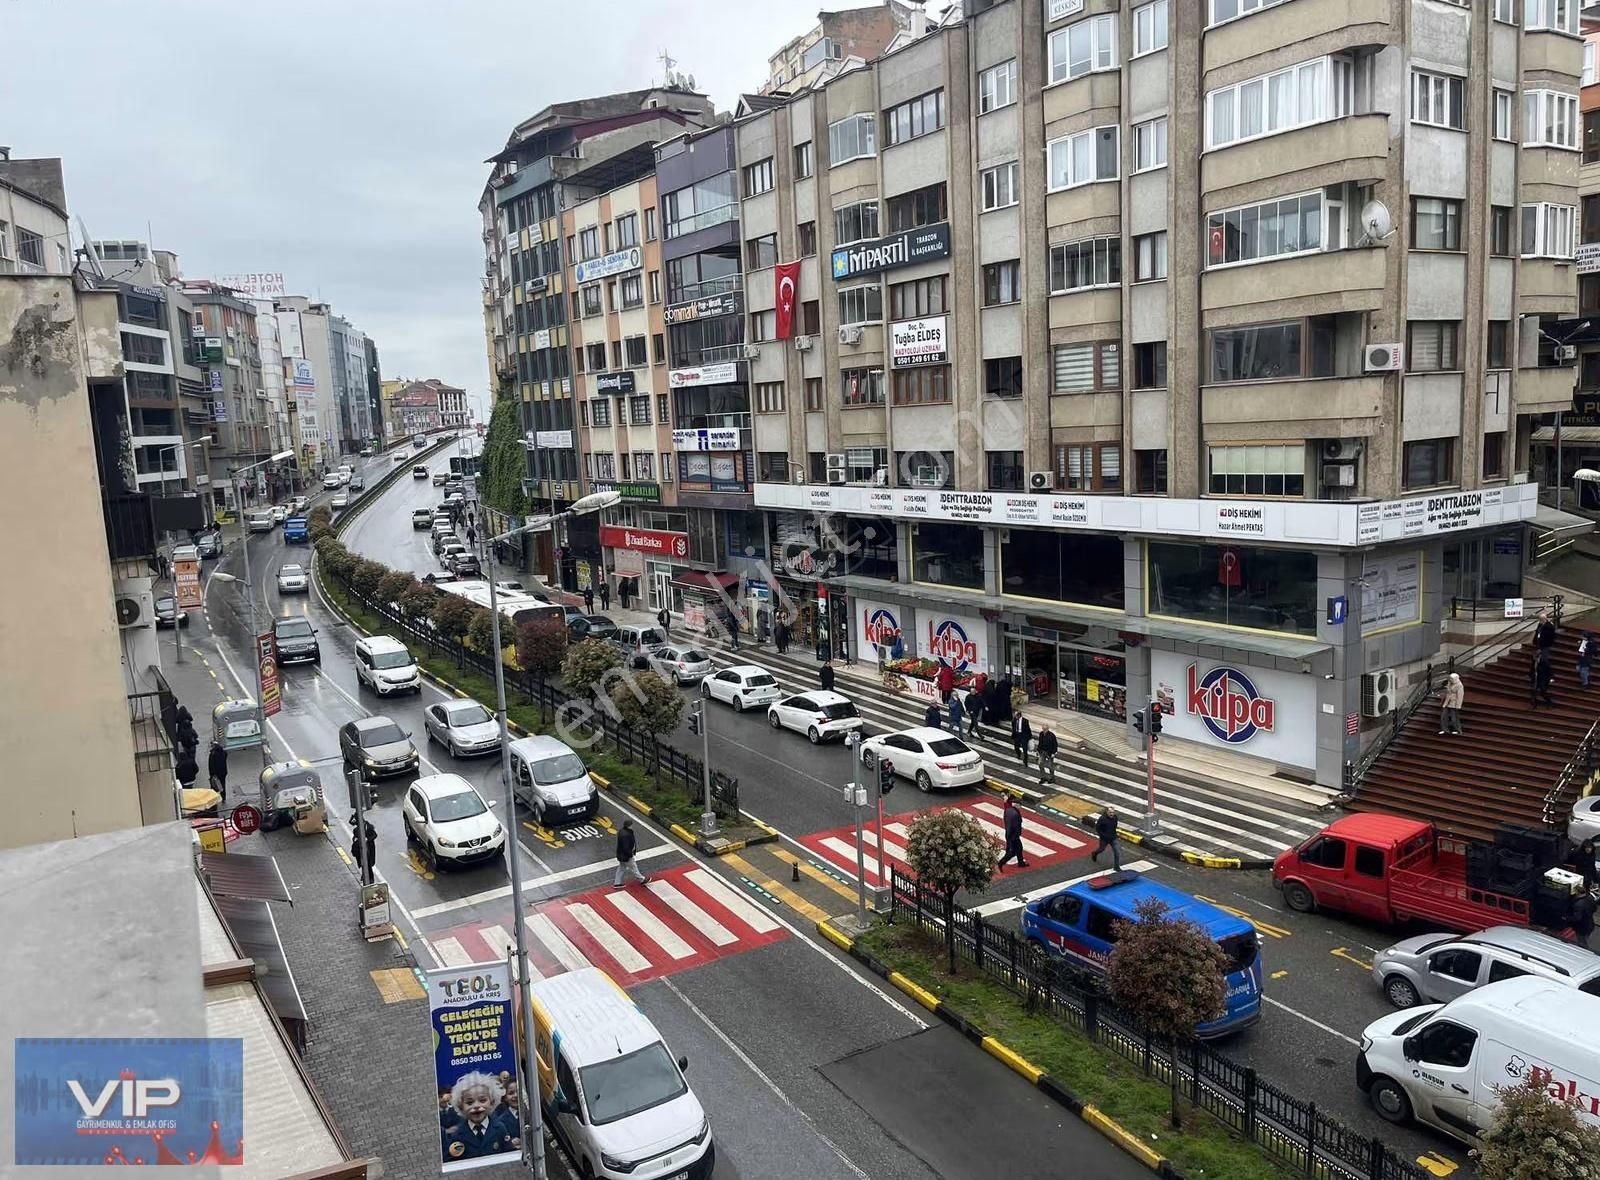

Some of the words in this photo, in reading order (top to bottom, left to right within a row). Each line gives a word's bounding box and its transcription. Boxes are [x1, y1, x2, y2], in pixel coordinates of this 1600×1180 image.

[916, 233, 937, 244] TRABZON
[894, 333, 916, 347] Tuğba
[917, 328, 941, 342] ELDEŞ
[1228, 507, 1238, 519] DİŞ
[1239, 508, 1262, 519] HEKİMİ
[929, 620, 977, 669] kilpa
[916, 680, 935, 697] TAZE
[1186, 661, 1274, 742] kilpa
[438, 974, 500, 998] TEOL
[443, 994, 478, 1004] ANAOKULU
[439, 1005, 504, 1023] GELECEĞİN
[444, 1015, 501, 1034] DAHİLERİ
[449, 1028, 499, 1044] TEOL'DE
[453, 1041, 497, 1056] BÜYÜR
[451, 1056, 468, 1066] 0850
